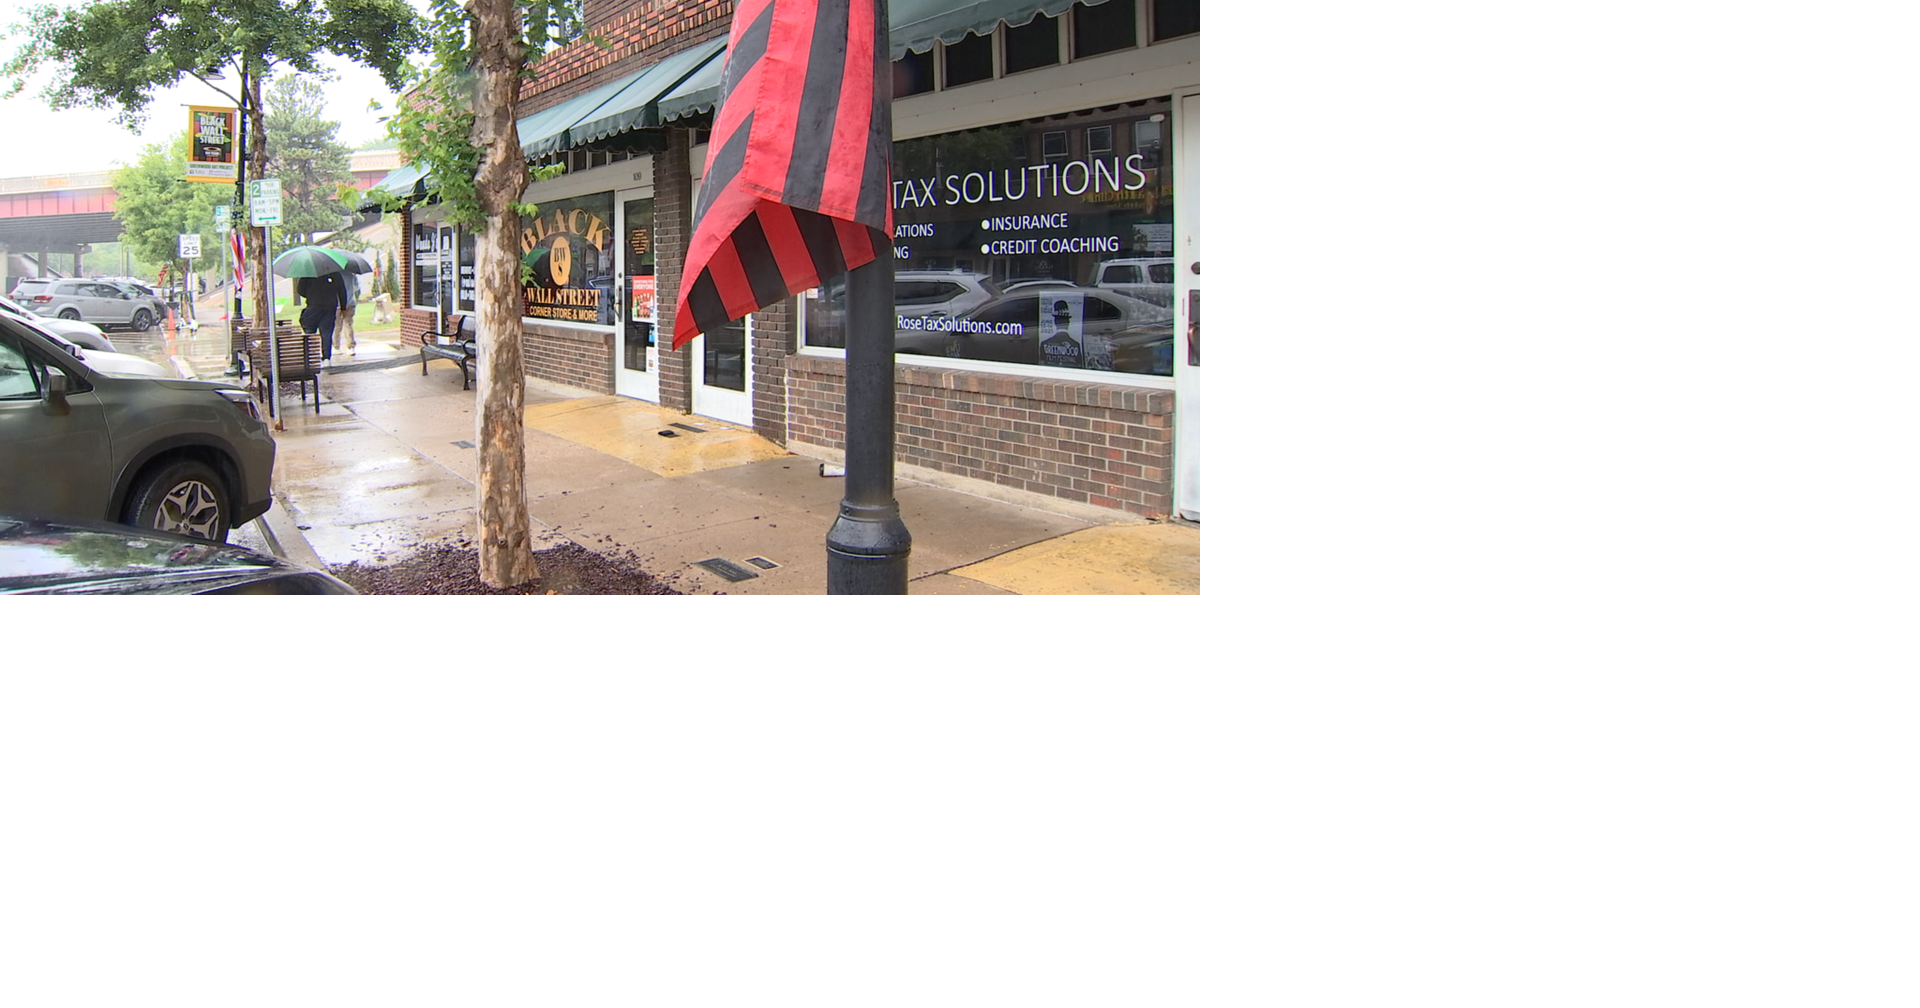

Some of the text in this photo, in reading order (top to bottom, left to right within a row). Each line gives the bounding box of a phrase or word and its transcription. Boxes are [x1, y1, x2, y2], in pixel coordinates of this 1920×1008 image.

[200, 116, 225, 126] BLACK
[200, 125, 225, 136] WALL
[199, 135, 224, 144] STREET
[633, 171, 642, 181] 109
[893, 154, 1146, 209] TAX SOLUTIONS
[252, 183, 260, 196] 2
[521, 208, 611, 255] BLACK
[894, 213, 1068, 238] ATIONS INSURANCE
[183, 246, 199, 255] 25
[991, 239, 1037, 255] CREDIT
[1041, 236, 1119, 254] COACHING
[554, 247, 567, 262] BW
[557, 263, 563, 276] S
[527, 288, 601, 307] WALL STREET
[530, 306, 598, 322] CORNER STORE & MORE
[897, 315, 1023, 336] RoseTaxSolutions.com
